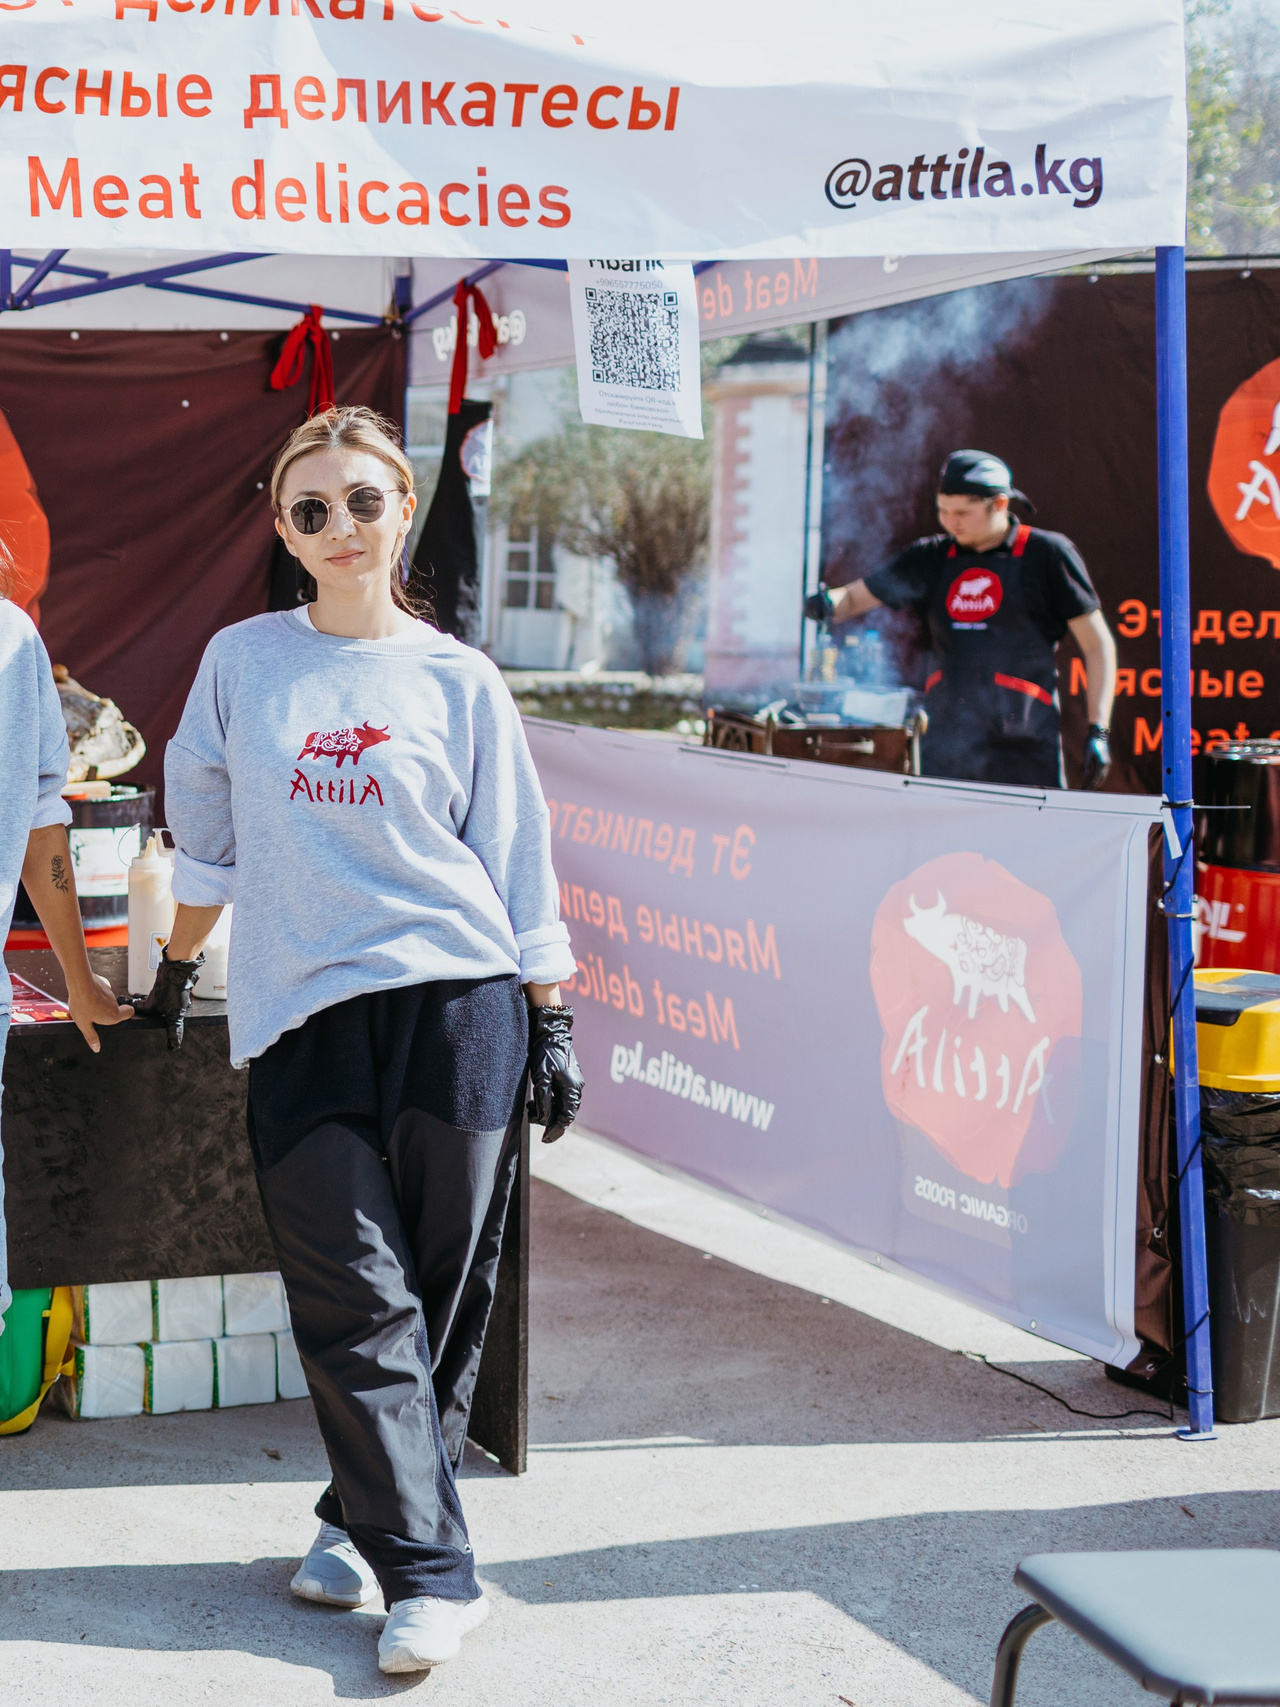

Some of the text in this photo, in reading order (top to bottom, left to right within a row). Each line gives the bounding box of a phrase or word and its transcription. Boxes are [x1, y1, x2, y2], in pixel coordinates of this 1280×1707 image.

[243, 73, 680, 131] деликатесы
[28, 155, 572, 229] Meat delicacies
[824, 143, 1104, 209] @attila.kg
